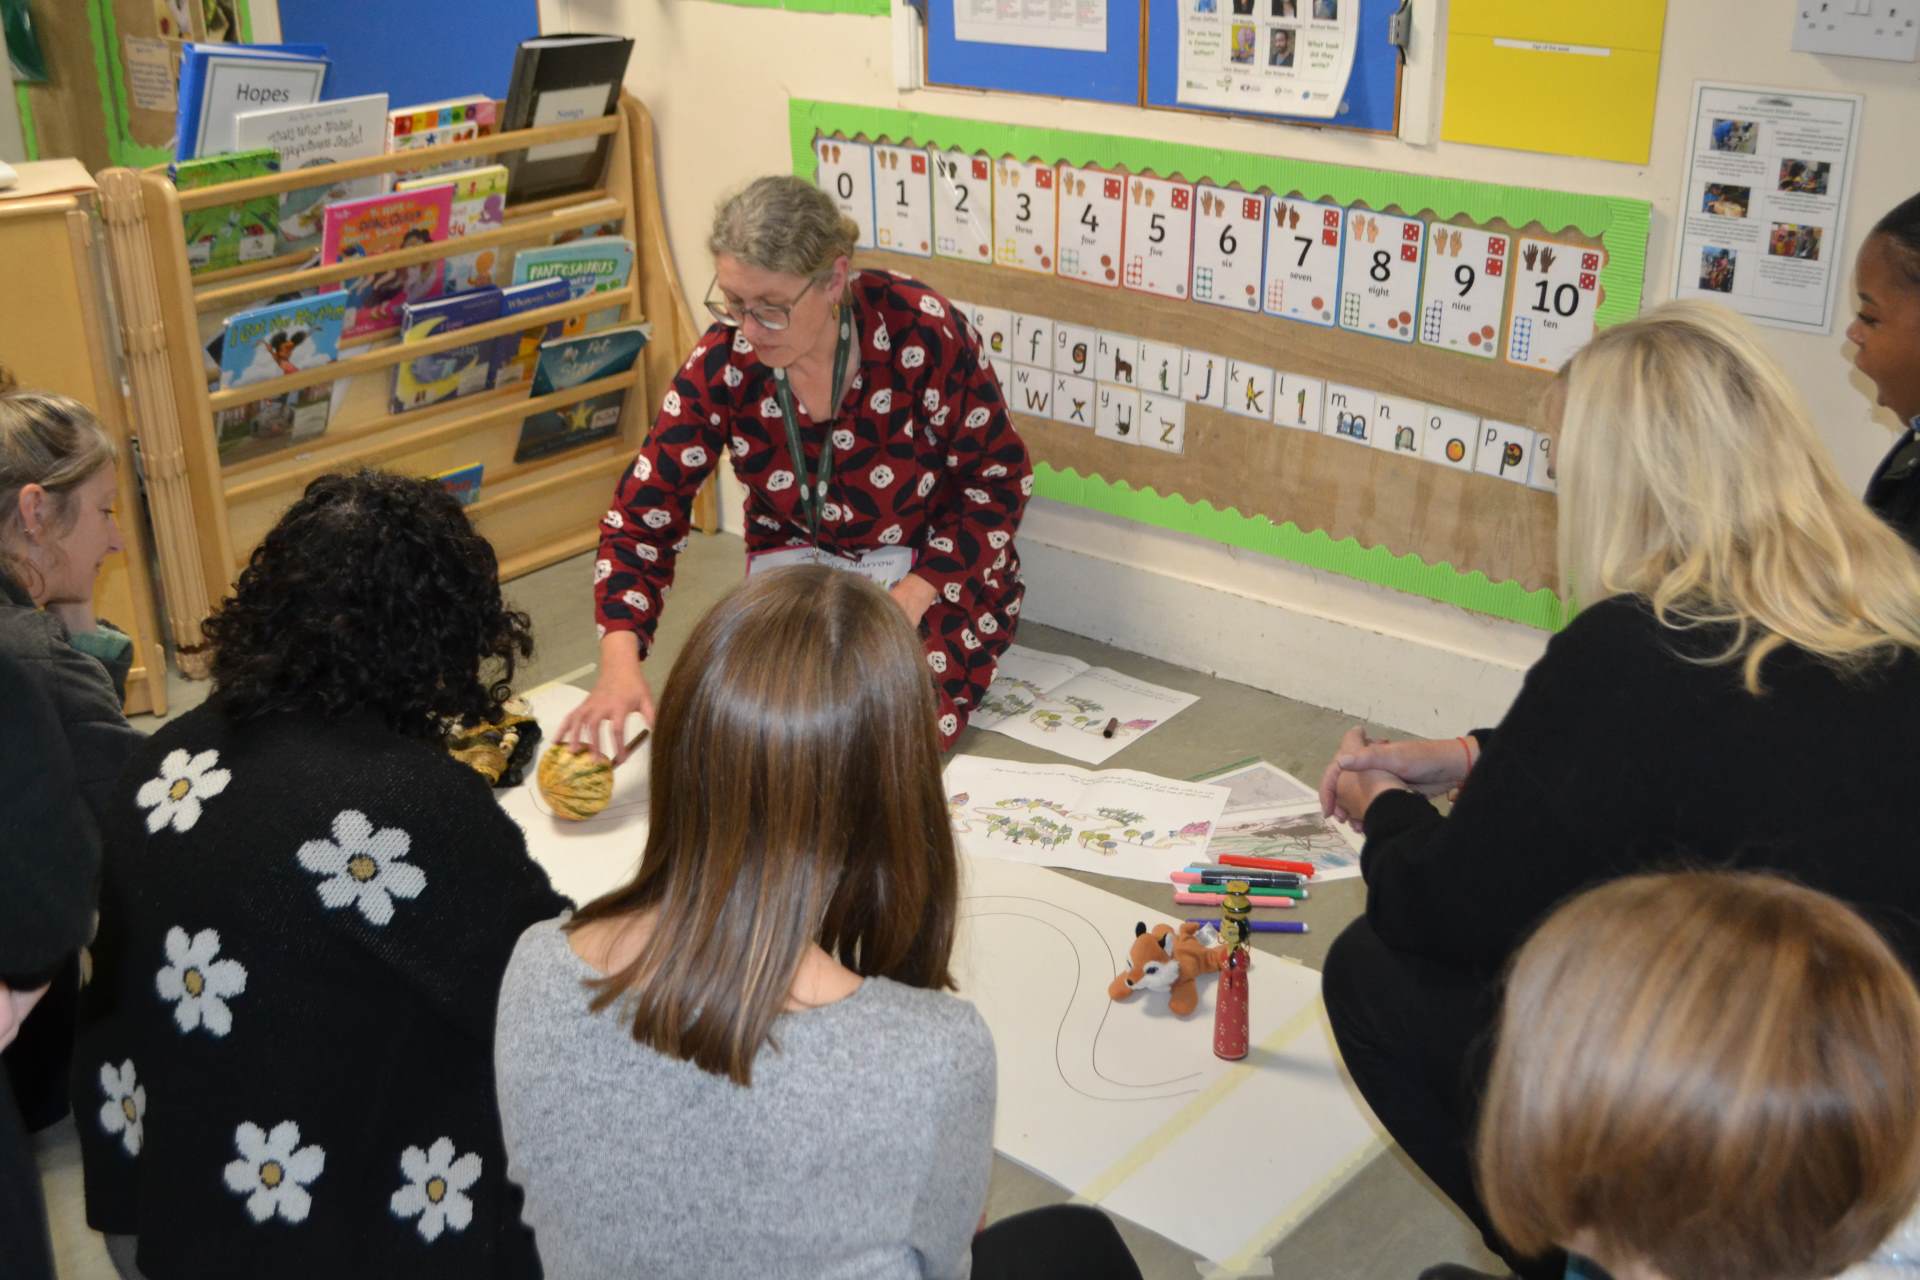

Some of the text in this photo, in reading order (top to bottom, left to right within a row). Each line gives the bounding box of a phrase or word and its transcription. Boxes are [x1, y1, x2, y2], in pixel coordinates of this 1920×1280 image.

[236, 84, 291, 105] Hopes
[837, 173, 853, 199] 0
[896, 180, 909, 207] 1
[955, 184, 969, 212] 2
[1016, 193, 1031, 221] 3
[1080, 204, 1099, 232] 4
[1015, 223, 1033, 234] three
[1149, 214, 1165, 243] 5
[1081, 235, 1096, 245] four
[1219, 224, 1237, 254] 6
[1150, 247, 1163, 256] five
[1294, 236, 1313, 266] 7
[530, 261, 614, 280] PANTOSAURUS
[1222, 259, 1233, 268] six
[1369, 251, 1391, 282] 8
[1290, 271, 1312, 282] seven
[1454, 265, 1475, 297] 9
[1368, 286, 1390, 298] eight
[1531, 280, 1579, 317] 10
[1451, 301, 1471, 312] nine
[976, 314, 984, 326] e
[1016, 316, 1022, 335] f
[1543, 319, 1558, 330] ten
[990, 332, 1003, 352] e
[1029, 330, 1042, 362] f
[1058, 331, 1067, 348] g
[1099, 336, 1107, 354] h
[1072, 343, 1087, 374] g
[1142, 344, 1146, 361] i
[1115, 348, 1132, 383] h
[1184, 353, 1191, 376] j
[1231, 362, 1239, 382] k
[1017, 370, 1029, 383] w
[1058, 380, 1065, 391] x
[1196, 360, 1213, 401] j
[1280, 376, 1284, 395] l
[1026, 388, 1048, 412] w
[1102, 390, 1109, 408] y
[1246, 377, 1263, 413] k
[1331, 393, 1347, 408] m
[1070, 398, 1086, 422] x
[1144, 400, 1152, 413] z
[1379, 404, 1390, 419] n
[1160, 417, 1175, 444] z
[1337, 411, 1367, 440] m
[1430, 416, 1441, 430] o
[1395, 425, 1416, 451] n
[1485, 428, 1497, 446] p
[1446, 438, 1465, 462] o
[1499, 441, 1523, 475] p
[1540, 438, 1551, 458] q
